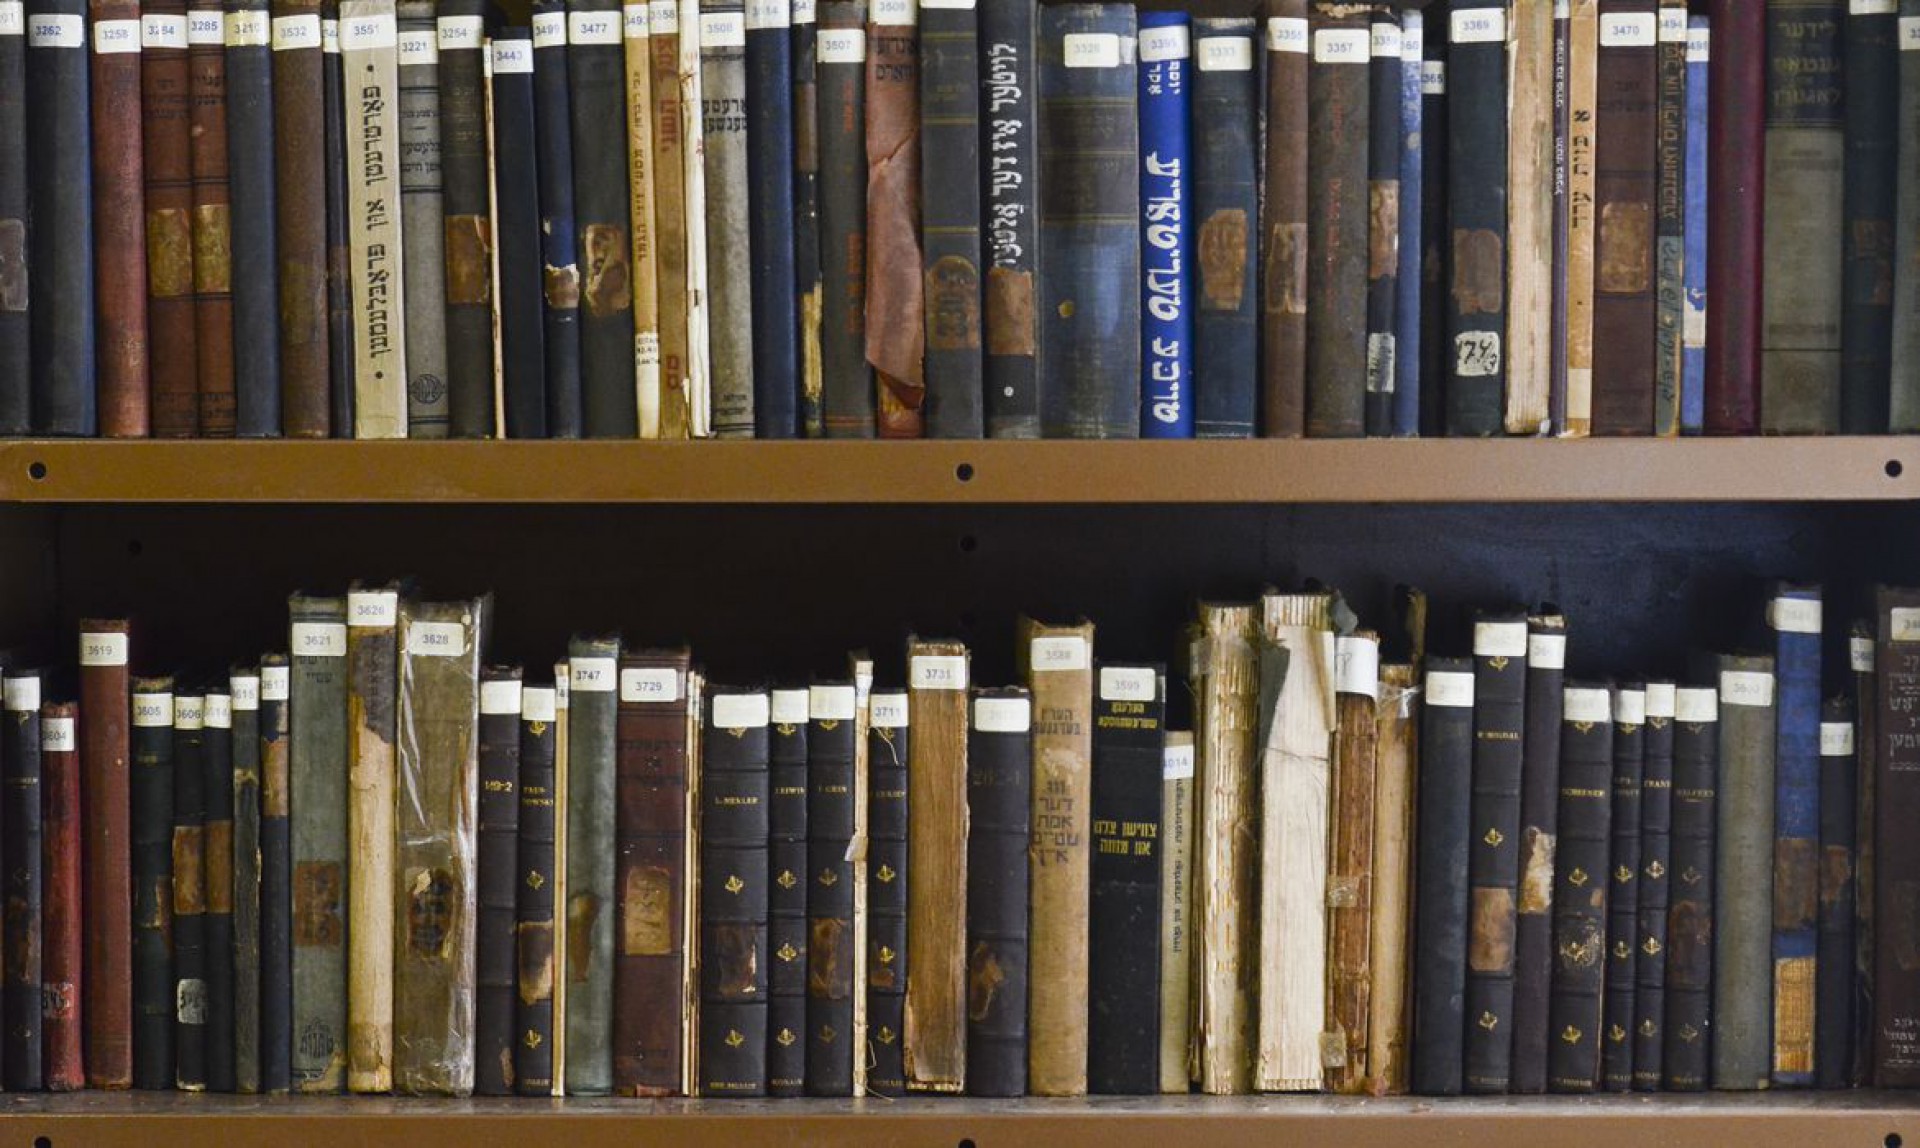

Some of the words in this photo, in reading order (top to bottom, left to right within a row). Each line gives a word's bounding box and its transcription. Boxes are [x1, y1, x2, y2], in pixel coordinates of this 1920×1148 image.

[581, 23, 608, 34] 3477
[1612, 25, 1640, 36] 3470
[575, 669, 601, 681] 3747
